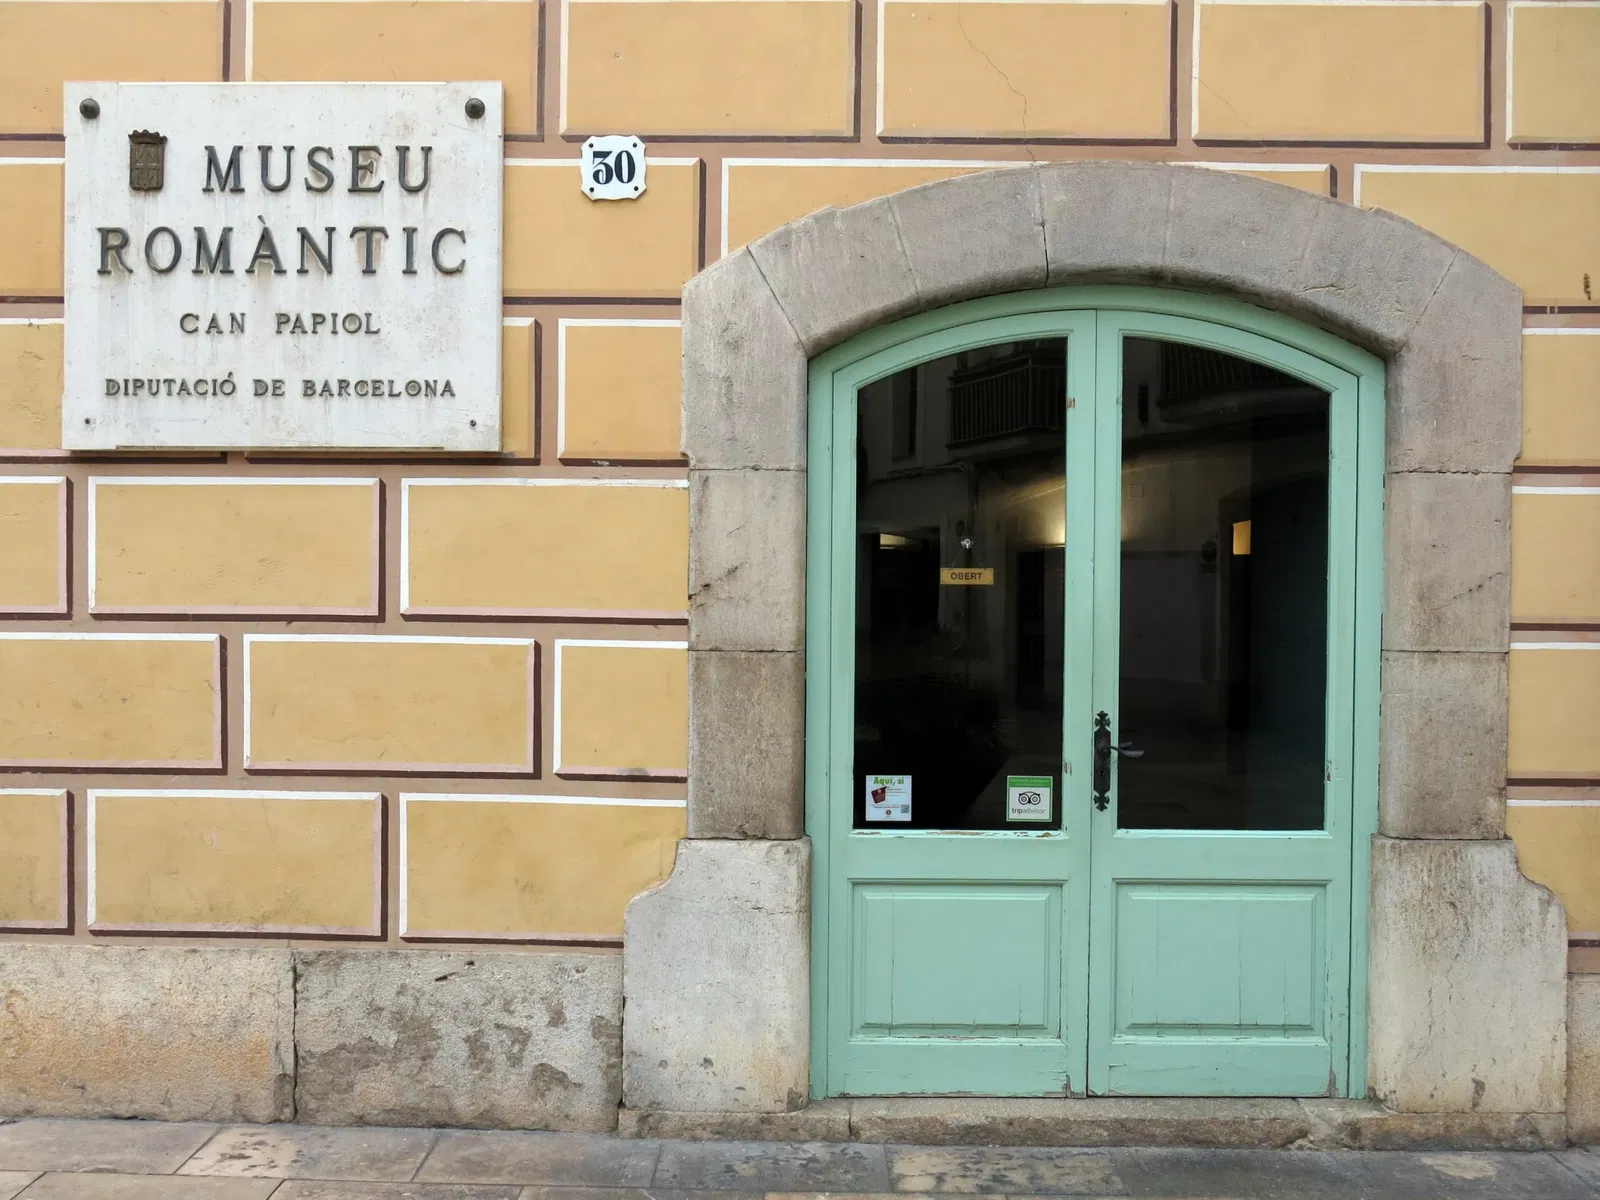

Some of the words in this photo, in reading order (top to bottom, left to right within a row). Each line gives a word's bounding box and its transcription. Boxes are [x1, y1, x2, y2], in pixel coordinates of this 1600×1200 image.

[202, 145, 433, 194] MUSEU
[592, 150, 636, 185] 30
[97, 215, 467, 275] ROMÀNTIC
[179, 312, 247, 334] CAN
[275, 312, 381, 335] PAPIOL
[105, 371, 237, 397] DIPUTACIÓ
[253, 379, 286, 397] DE
[302, 379, 456, 398] BARCELONA
[950, 572, 983, 580] OBERT
